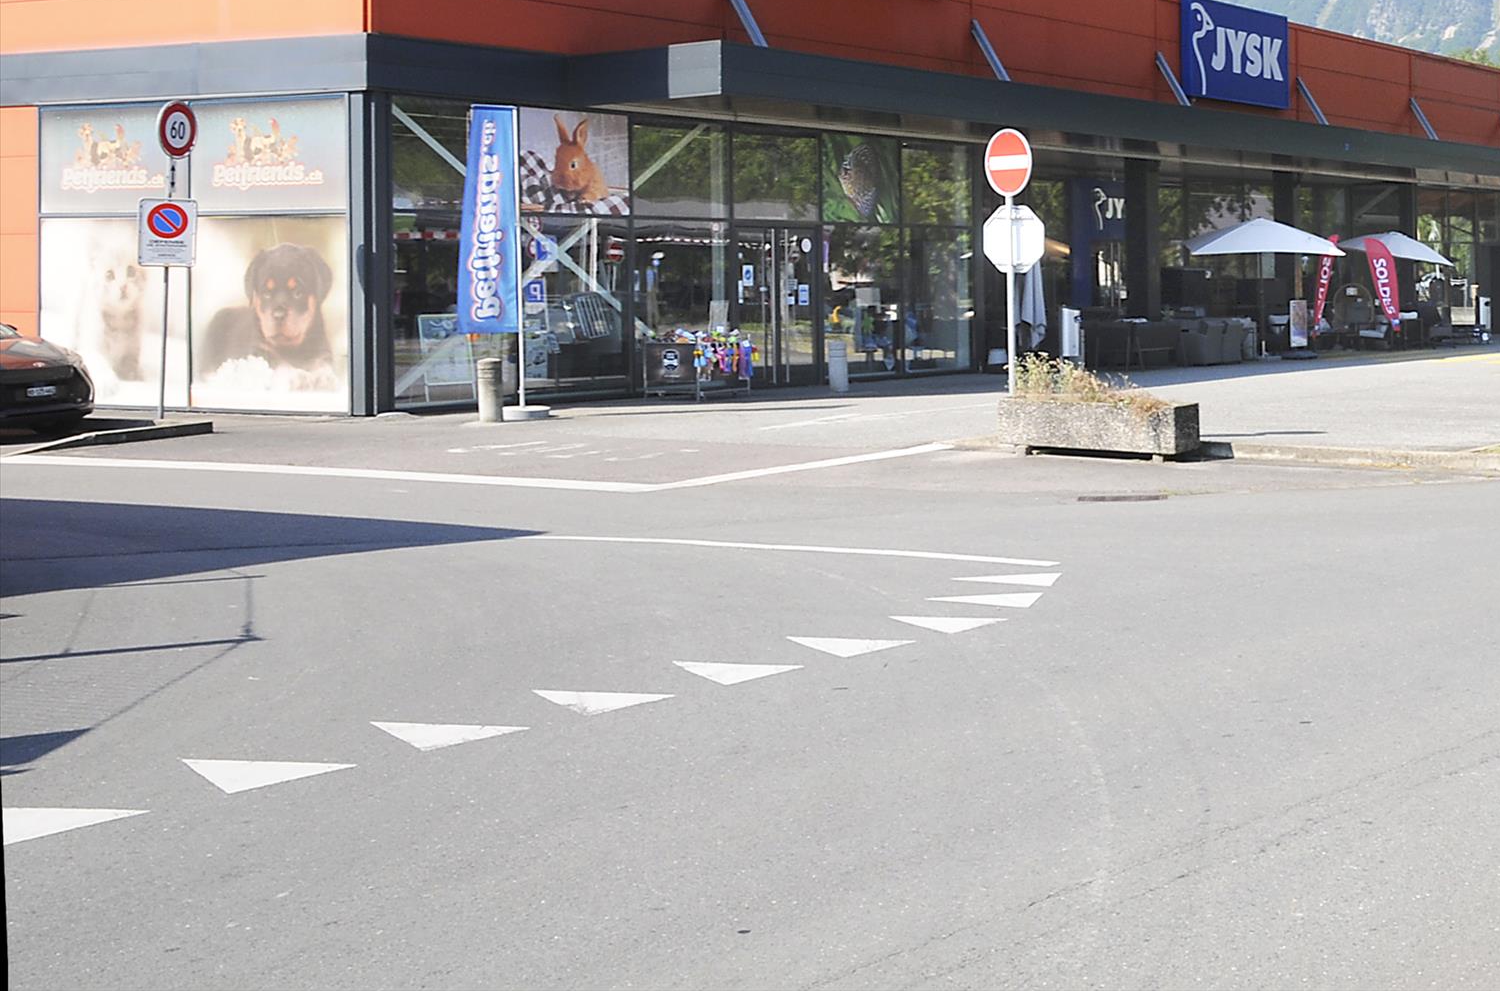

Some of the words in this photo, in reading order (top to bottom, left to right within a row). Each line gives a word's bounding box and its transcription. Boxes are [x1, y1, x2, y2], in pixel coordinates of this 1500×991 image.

[1211, 26, 1284, 81] JYSK
[170, 120, 186, 140] 60
[212, 161, 325, 192] Petfriends.ch
